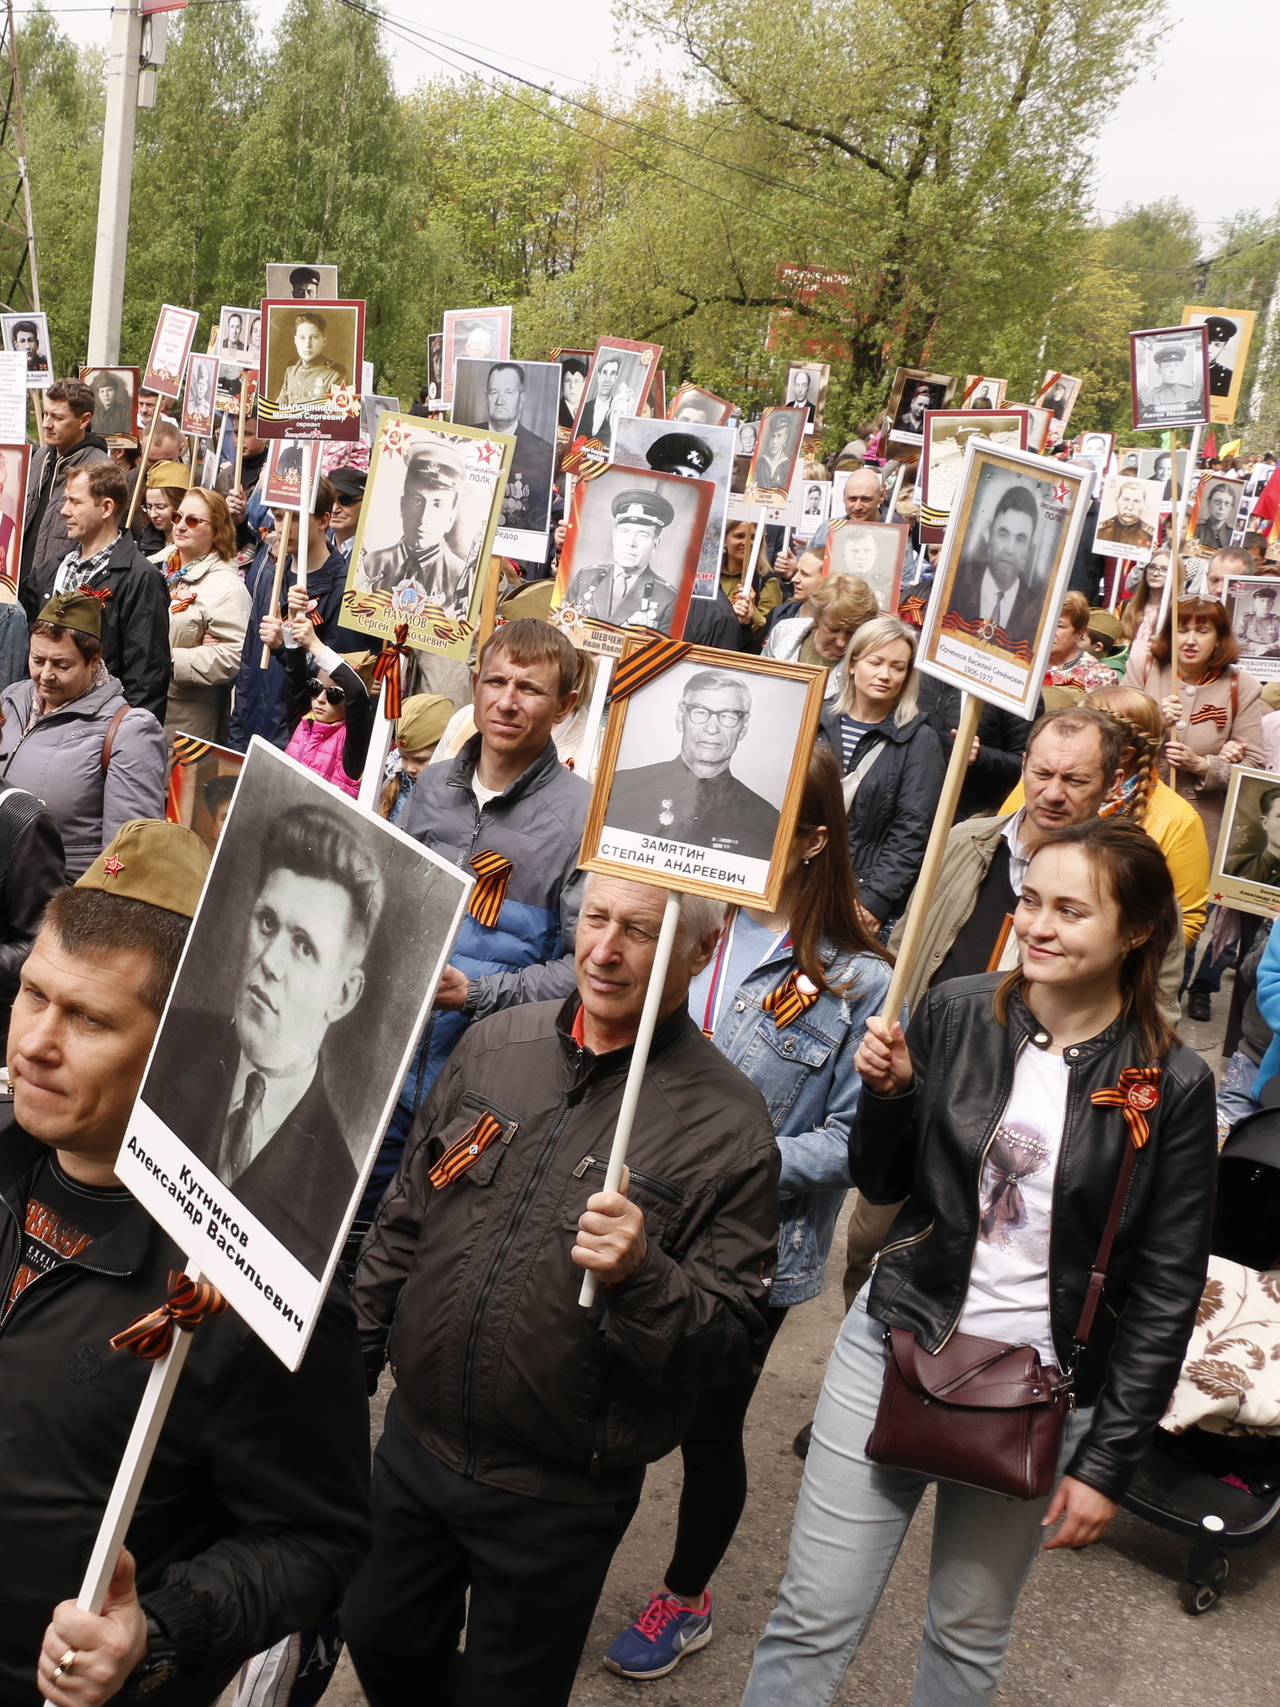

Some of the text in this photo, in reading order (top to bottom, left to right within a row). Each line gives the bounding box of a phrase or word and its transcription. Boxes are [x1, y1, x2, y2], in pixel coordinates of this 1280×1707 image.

[272, 411, 347, 424] Михаил Сергеевич
[469, 473, 491, 485] ПОЛК
[1044, 511, 1064, 523] ПОЛК
[358, 613, 389, 632] Сергей
[383, 605, 429, 629] НАУМОВ
[582, 638, 622, 654] Иван Павло
[591, 631, 625, 645] ШЕВЧЕН
[967, 656, 992, 672] Василий
[992, 666, 1025, 687] Семёнович
[641, 837, 706, 861] ЗАМЯТИН
[601, 844, 746, 885] СТЕПАН АНДРЕЕВИЧ
[179, 1164, 250, 1248] Кутников
[127, 1135, 304, 1333] Александр Васильевич
